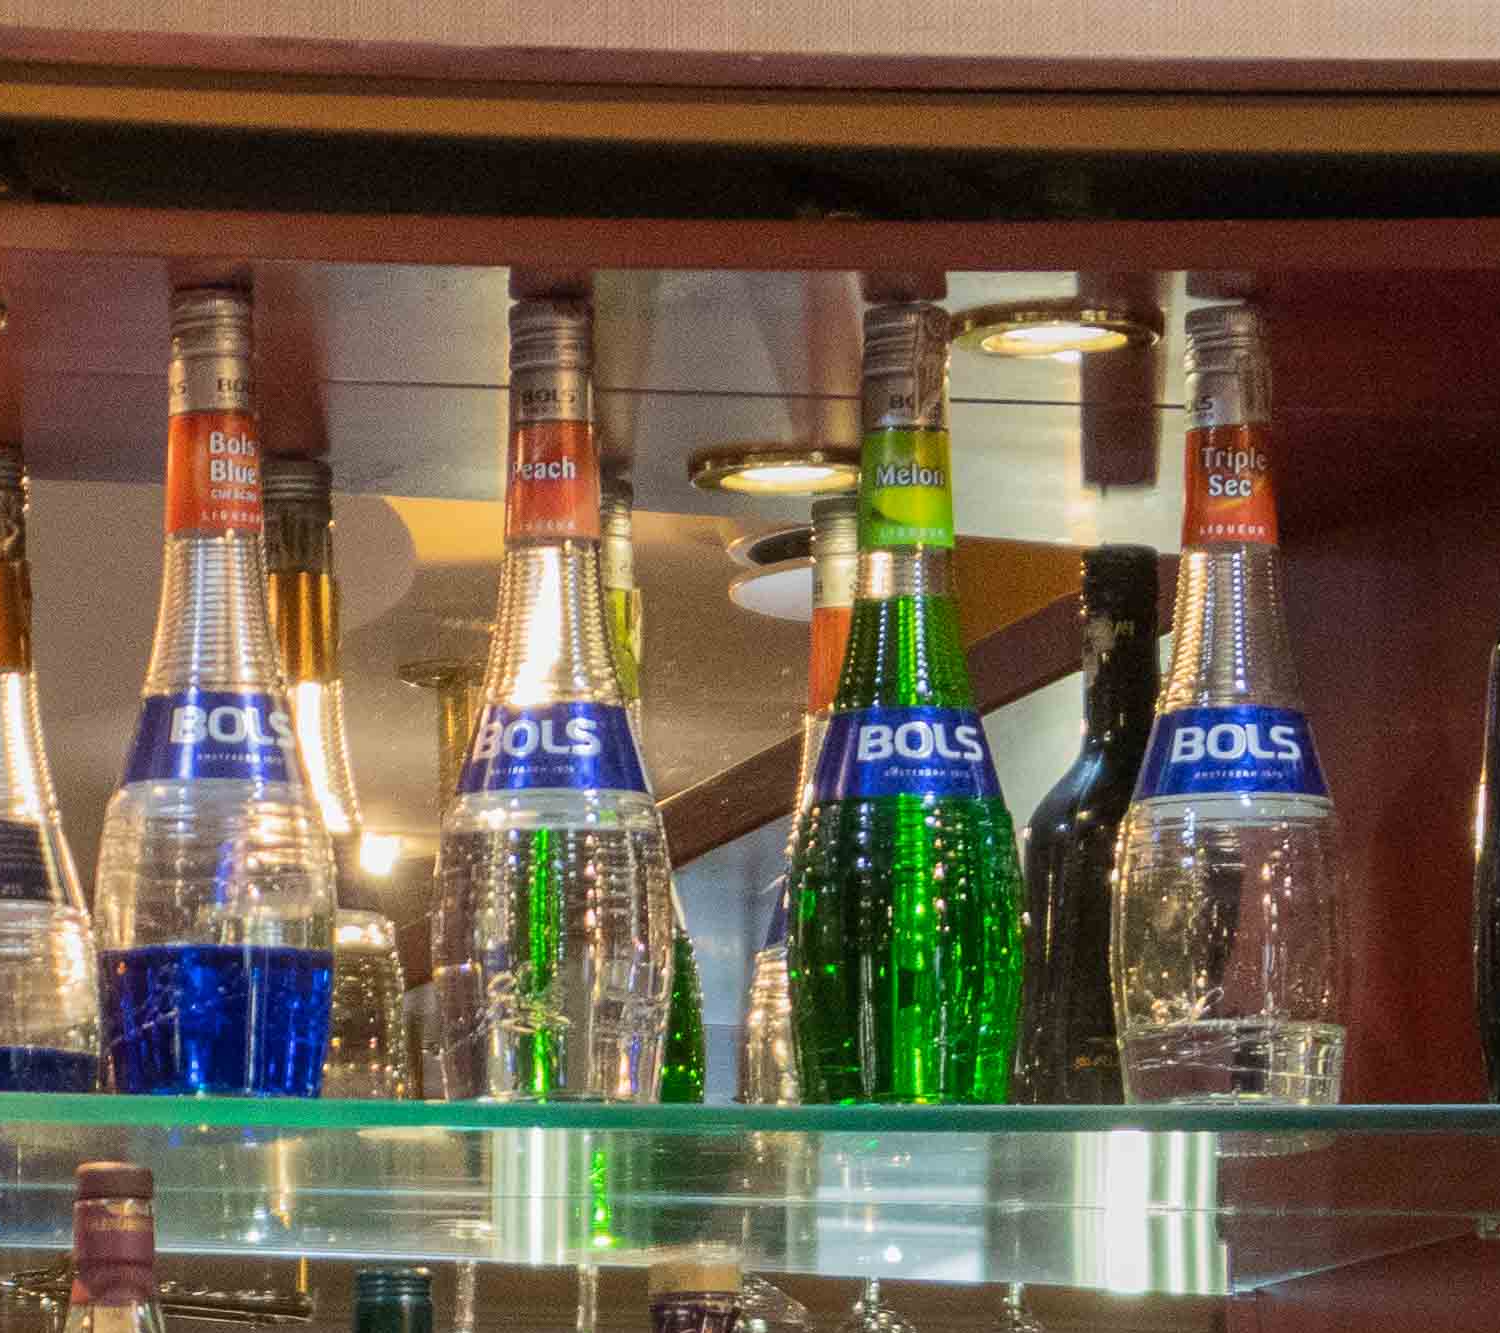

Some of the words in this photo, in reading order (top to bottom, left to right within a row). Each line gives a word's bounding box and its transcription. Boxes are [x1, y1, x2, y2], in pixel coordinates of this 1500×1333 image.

[209, 432, 256, 455] Bols
[209, 460, 257, 485] Blue
[874, 463, 945, 487] Melon
[1202, 447, 1268, 475] Triple
[1207, 474, 1253, 497] Sec
[170, 706, 294, 747] BOLS
[474, 718, 602, 759] BOLS
[857, 721, 983, 761] BOLS
[1170, 722, 1301, 763] BOLS
